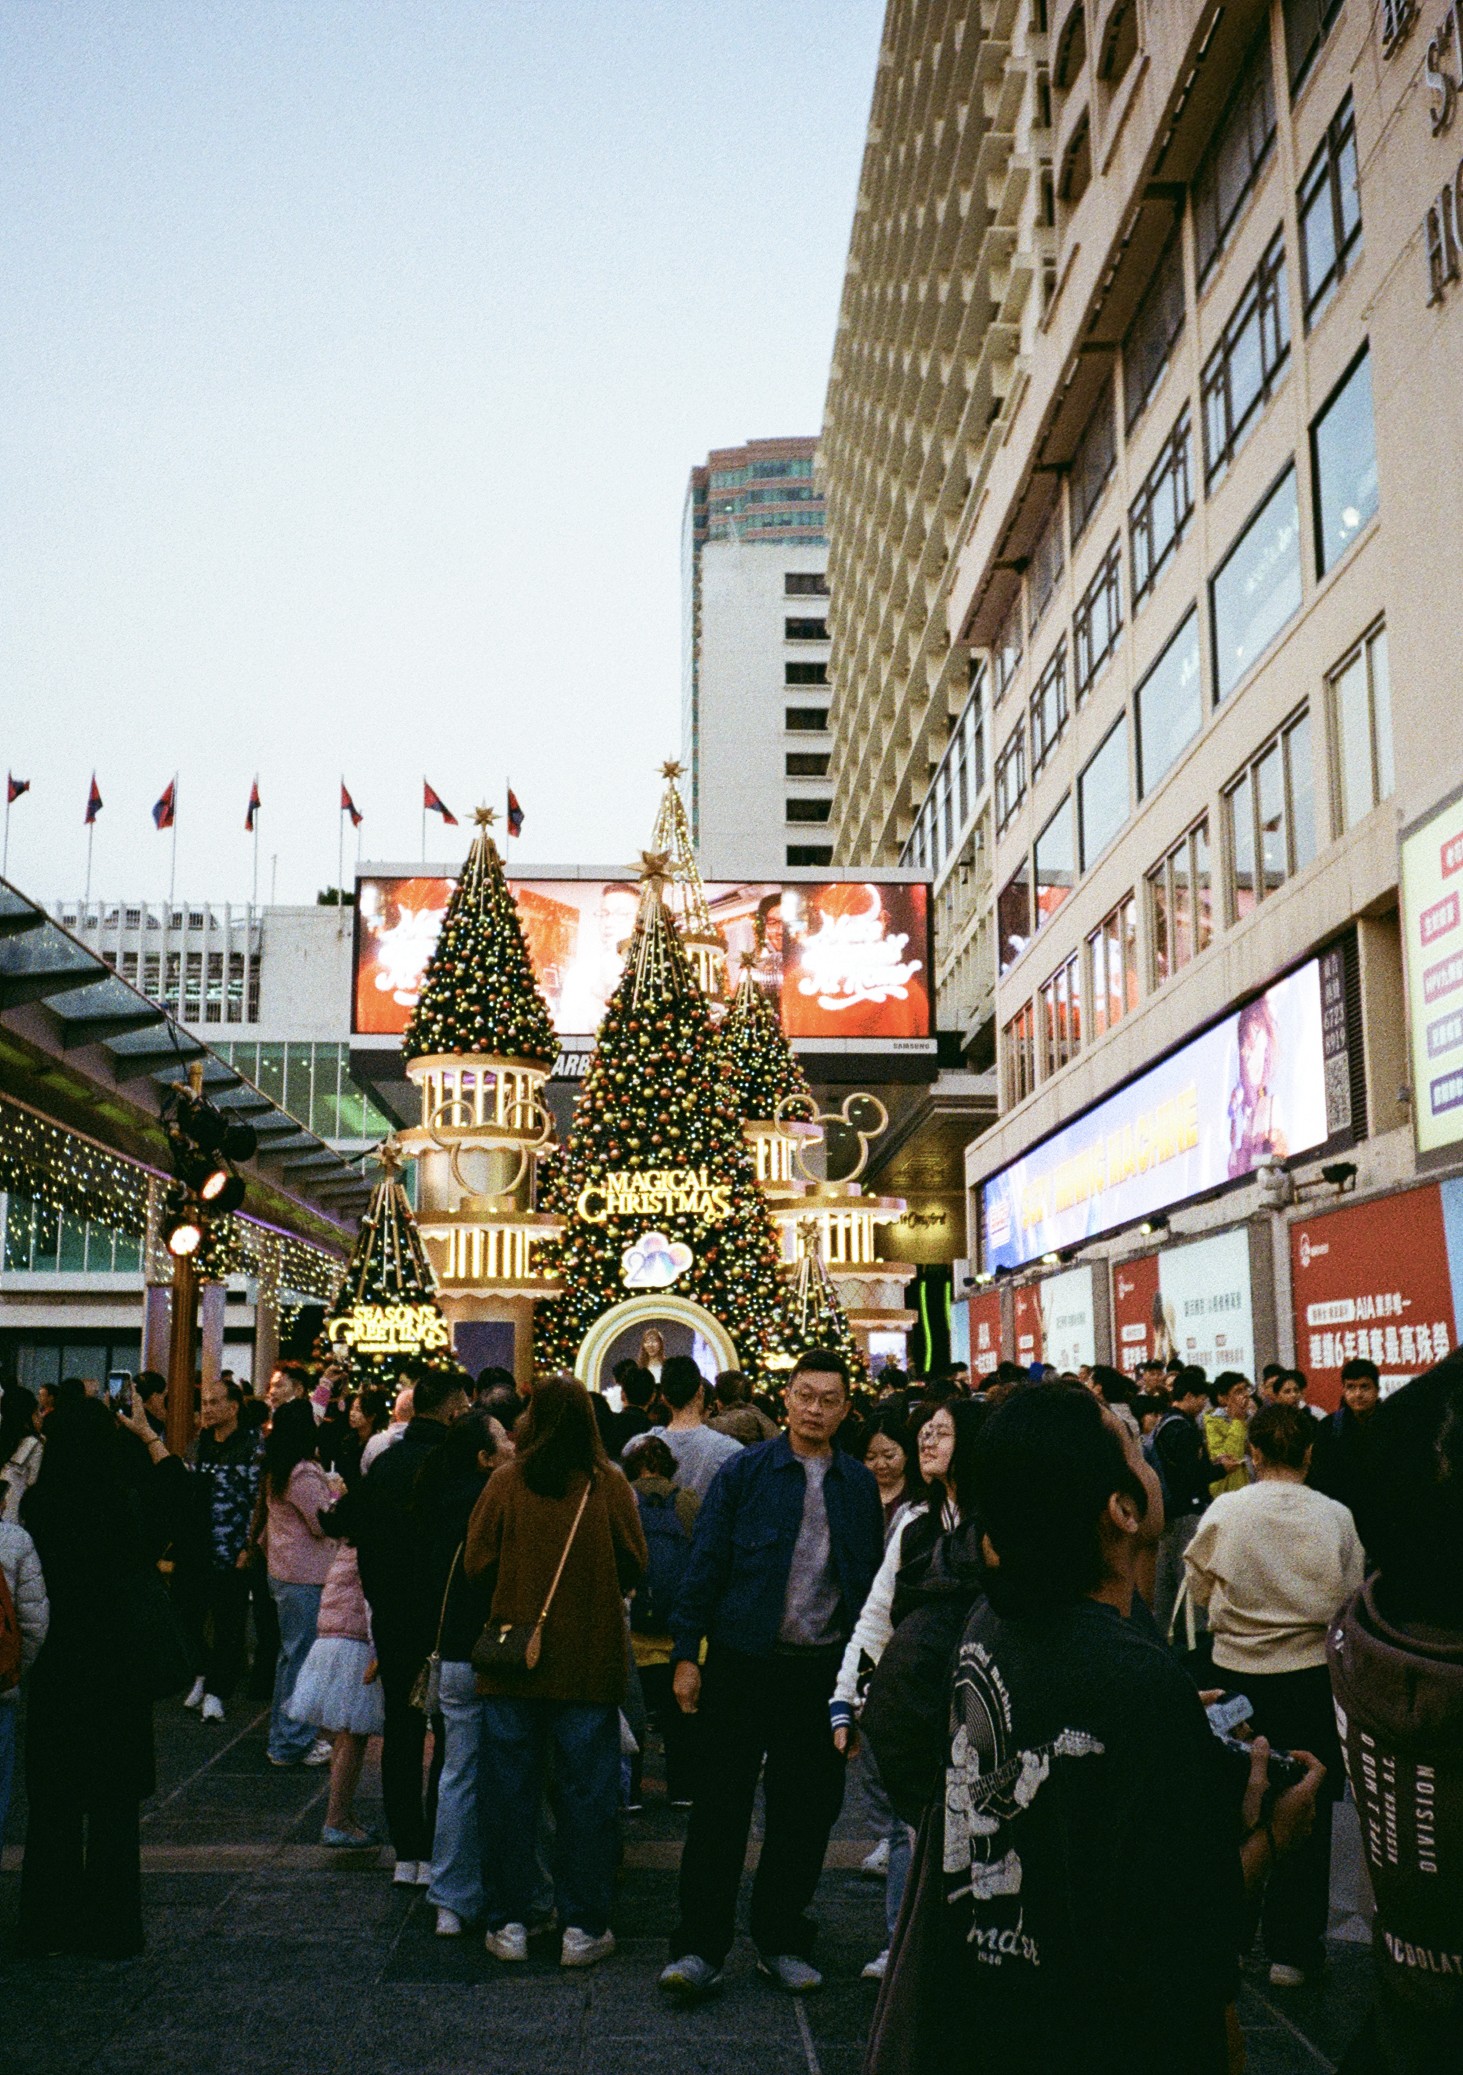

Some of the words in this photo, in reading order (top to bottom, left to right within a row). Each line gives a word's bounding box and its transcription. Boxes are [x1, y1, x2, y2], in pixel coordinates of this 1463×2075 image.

[893, 1042, 930, 1050] SAMSUNG
[606, 1170, 714, 1192] MAGICAL
[577, 1186, 731, 1223] CHRISTMAS
[329, 1317, 449, 1349] GREETINGS
[1362, 1752, 1378, 1795] MOD
[1416, 1764, 1437, 1873] DIVISION
[1369, 1817, 1383, 1867] TYPE
